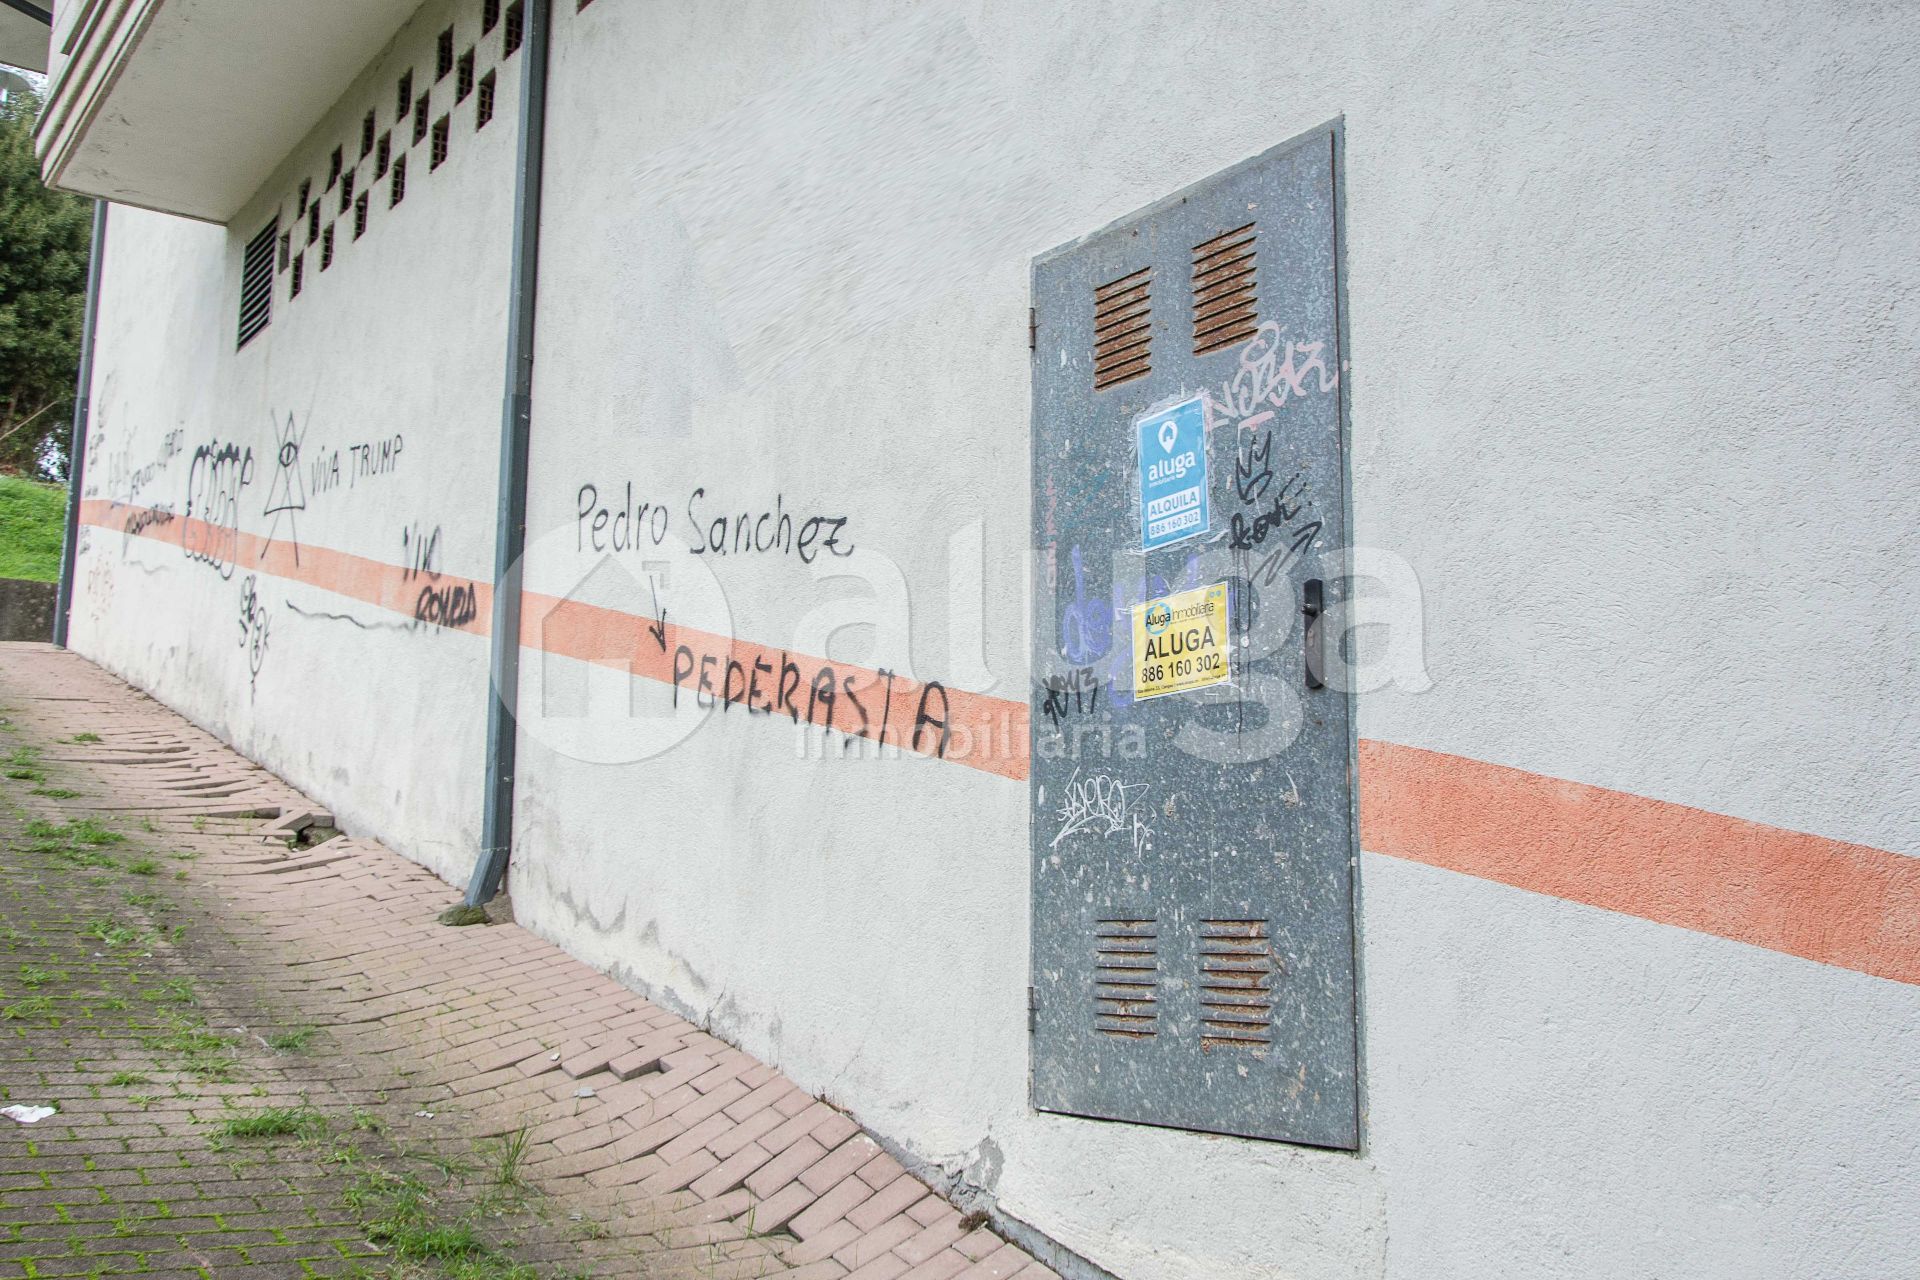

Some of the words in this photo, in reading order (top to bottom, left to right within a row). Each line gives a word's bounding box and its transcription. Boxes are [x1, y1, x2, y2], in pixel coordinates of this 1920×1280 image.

[350, 434, 403, 489] TRUMP
[1148, 451, 1196, 479] aluga
[1149, 491, 1197, 517] ALQUILA
[577, 481, 668, 553] Pedro
[687, 488, 855, 564] Sanchez
[1150, 524, 1166, 536] 886
[1167, 518, 1182, 530] 160
[1184, 512, 1199, 525] 302
[1145, 612, 1171, 627] Aluga
[1144, 626, 1215, 661] ALUGA
[1141, 664, 1164, 683] 886
[1168, 659, 1192, 678] 160
[1196, 653, 1220, 673] 302
[672, 645, 951, 759] PEDERASTA
